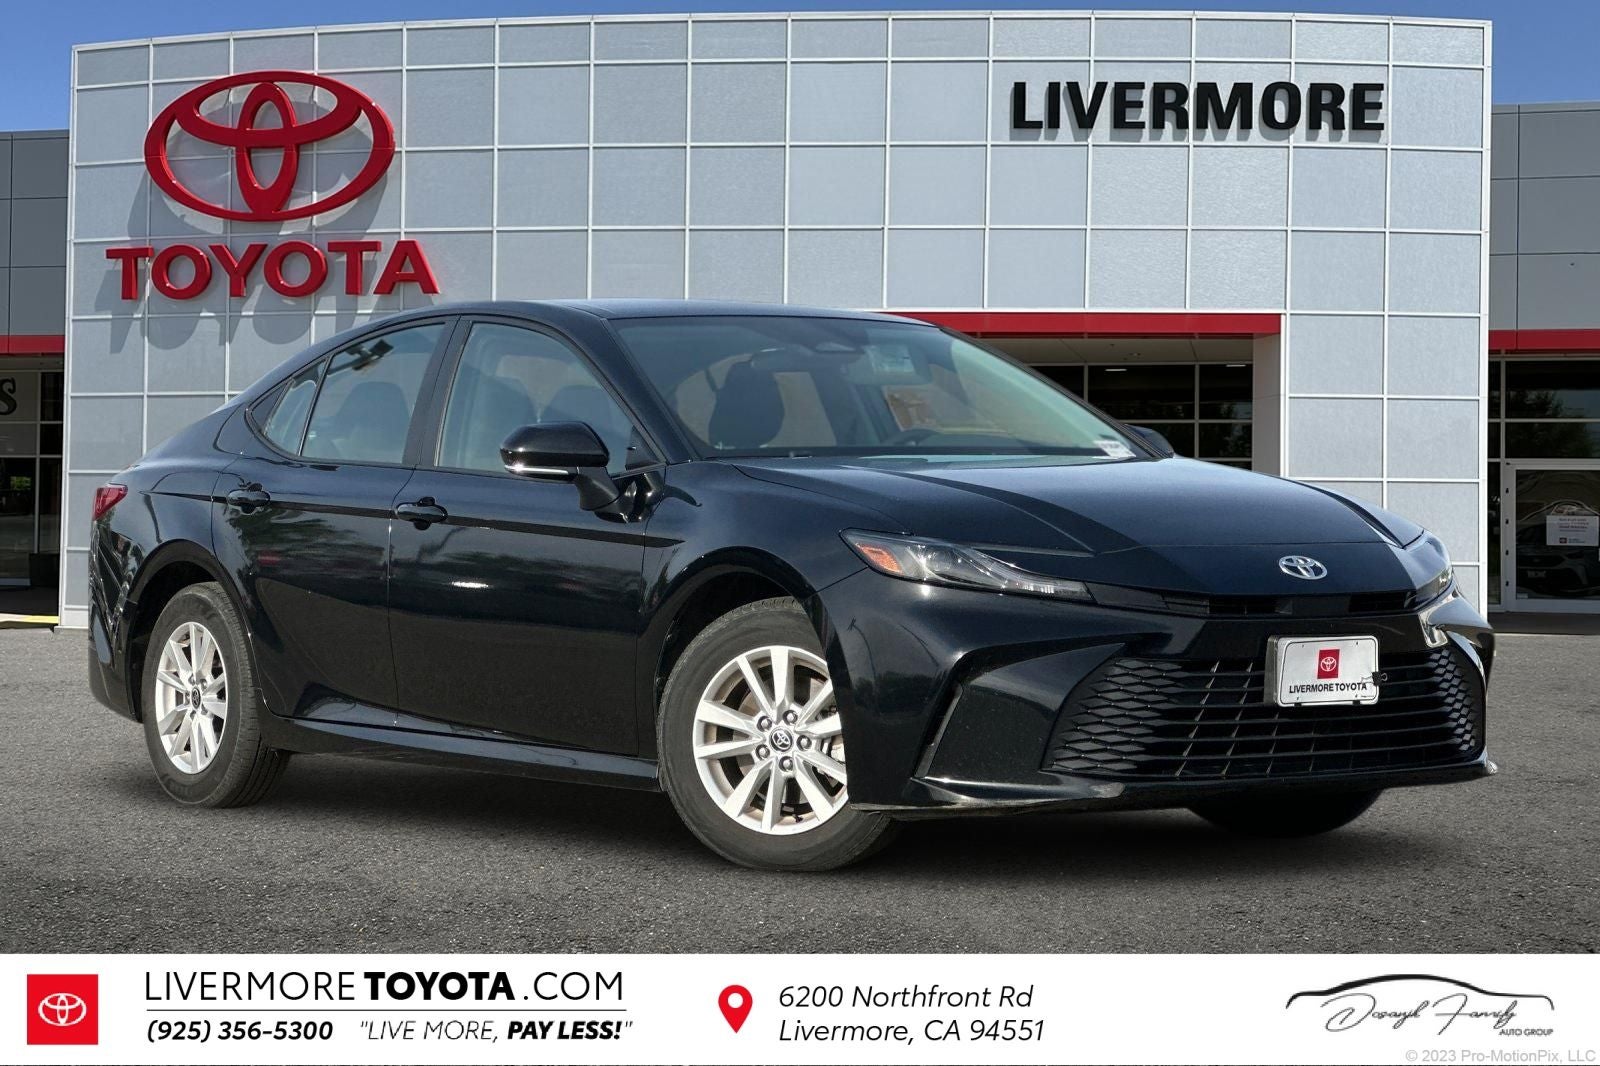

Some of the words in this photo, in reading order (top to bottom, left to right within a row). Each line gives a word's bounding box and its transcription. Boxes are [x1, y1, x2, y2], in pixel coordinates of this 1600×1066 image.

[1012, 81, 1385, 131] LIVERMORE
[106, 240, 440, 300] TOYOTA
[1289, 683, 1334, 694] LIVERMORE
[1335, 681, 1368, 692] TOYOTA
